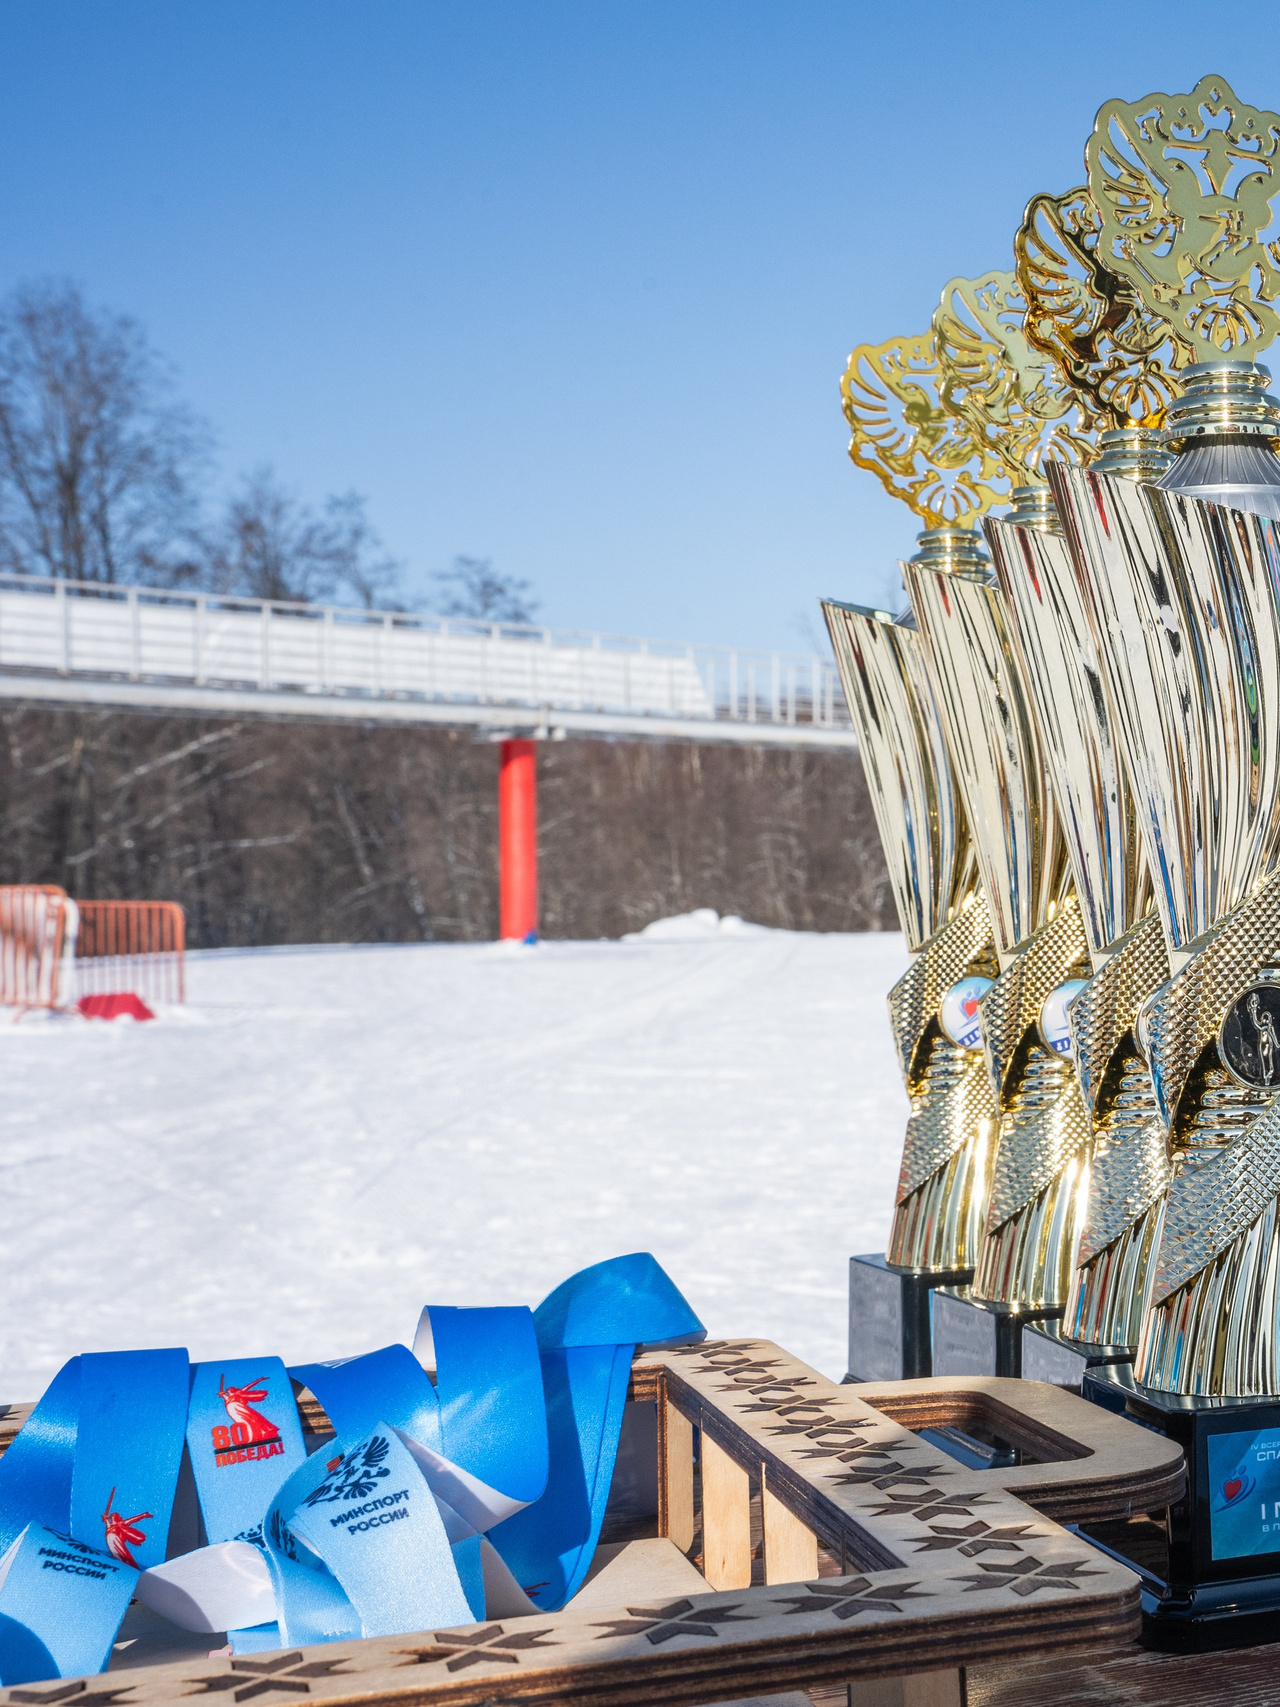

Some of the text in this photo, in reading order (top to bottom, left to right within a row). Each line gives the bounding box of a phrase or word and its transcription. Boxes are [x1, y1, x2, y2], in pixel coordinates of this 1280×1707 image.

[211, 1422, 250, 1449] 80
[215, 1441, 284, 1468] ПОБЕДА!
[330, 1490, 410, 1527] МИНСПОРТ
[347, 1507, 410, 1535] РОССИИ
[1261, 1503, 1265, 1520] I
[1262, 1524, 1270, 1532] В
[38, 1547, 120, 1573] МИНСПОРТ
[42, 1560, 107, 1580] РОССИИ
